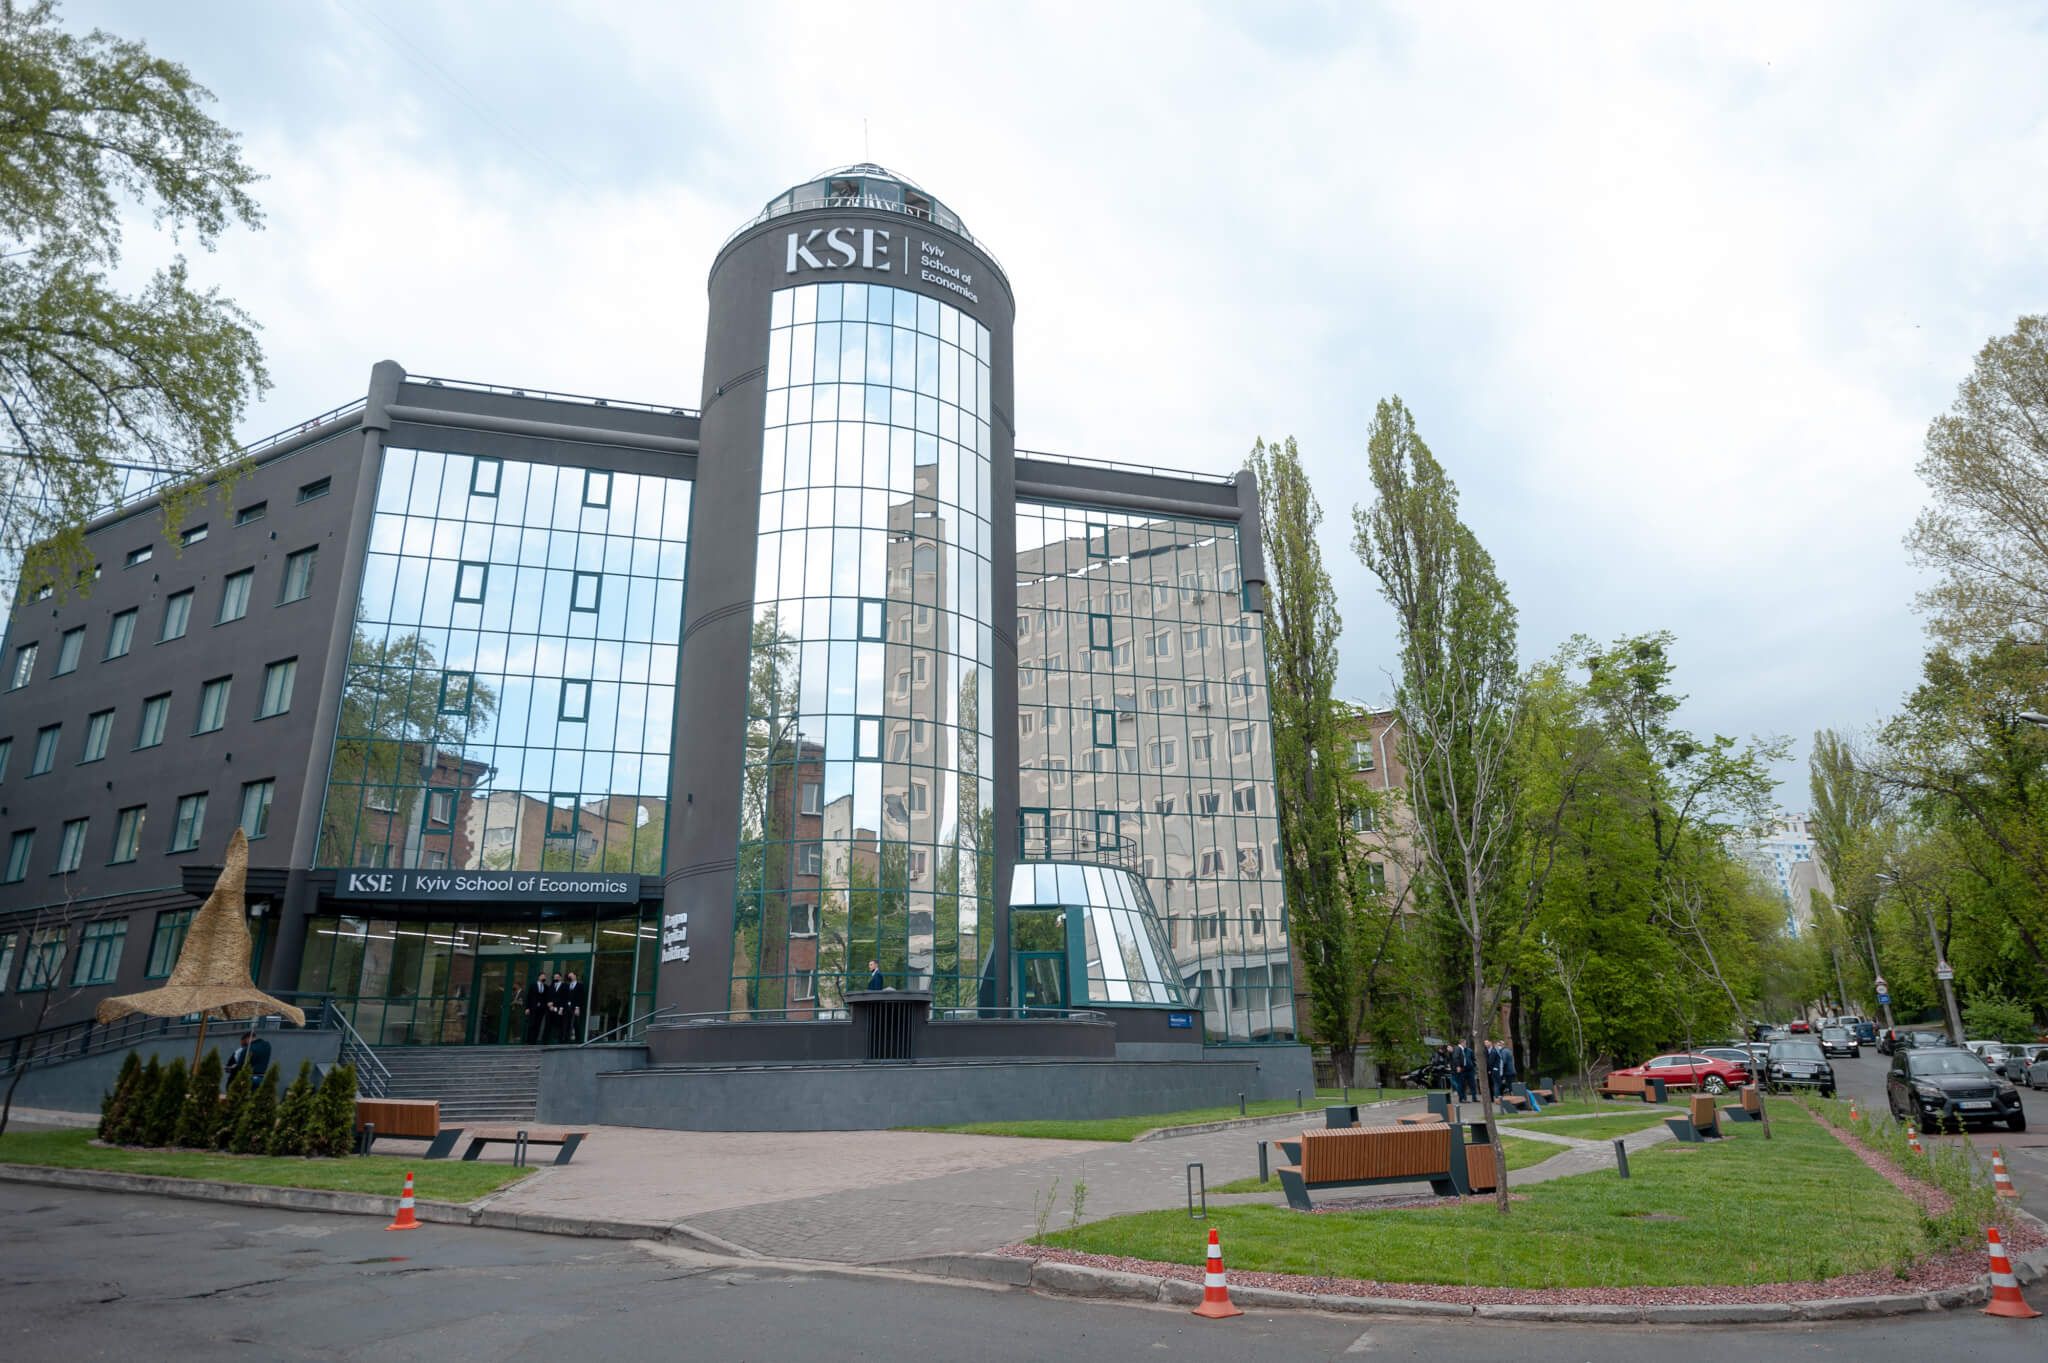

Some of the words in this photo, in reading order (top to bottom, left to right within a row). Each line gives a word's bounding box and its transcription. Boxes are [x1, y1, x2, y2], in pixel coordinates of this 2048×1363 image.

[786, 227, 890, 273] KSE
[921, 240, 945, 257] Kyiv
[921, 255, 960, 279] School
[961, 274, 972, 285] of
[921, 269, 978, 303] Economics
[348, 873, 393, 892] KSE
[416, 875, 451, 892] Kyiv
[455, 876, 514, 892] School
[518, 877, 536, 892] of
[539, 878, 628, 893] Economics
